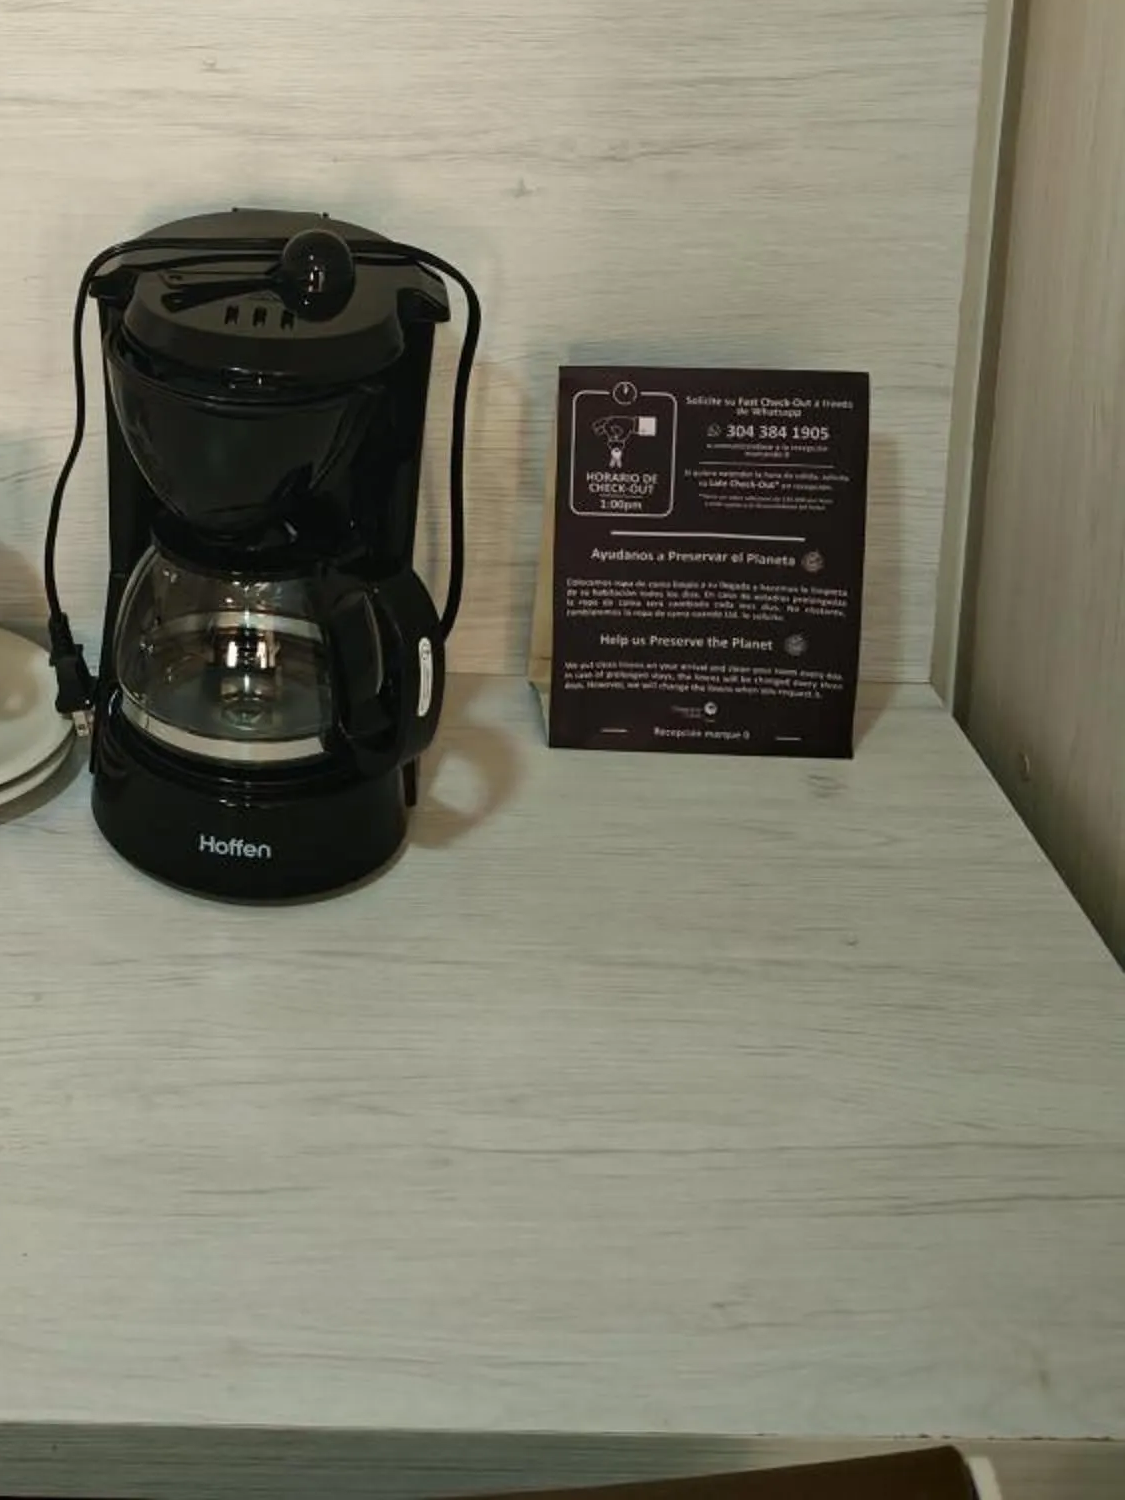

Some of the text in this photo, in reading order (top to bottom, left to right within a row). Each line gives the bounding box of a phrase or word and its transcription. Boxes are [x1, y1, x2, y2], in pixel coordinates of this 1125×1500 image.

[726, 425, 830, 440] 304 384 1905
[586, 471, 658, 484] HORARIO DE
[588, 483, 654, 494] CHECK-OUT
[600, 499, 642, 511] 1:00pm
[657, 553, 664, 562] a
[668, 550, 728, 563] Preservar
[730, 552, 744, 563] el
[746, 553, 796, 566] Planeta
[600, 633, 773, 651] Help us Preserve the Planet
[199, 833, 271, 858] Hoffen
